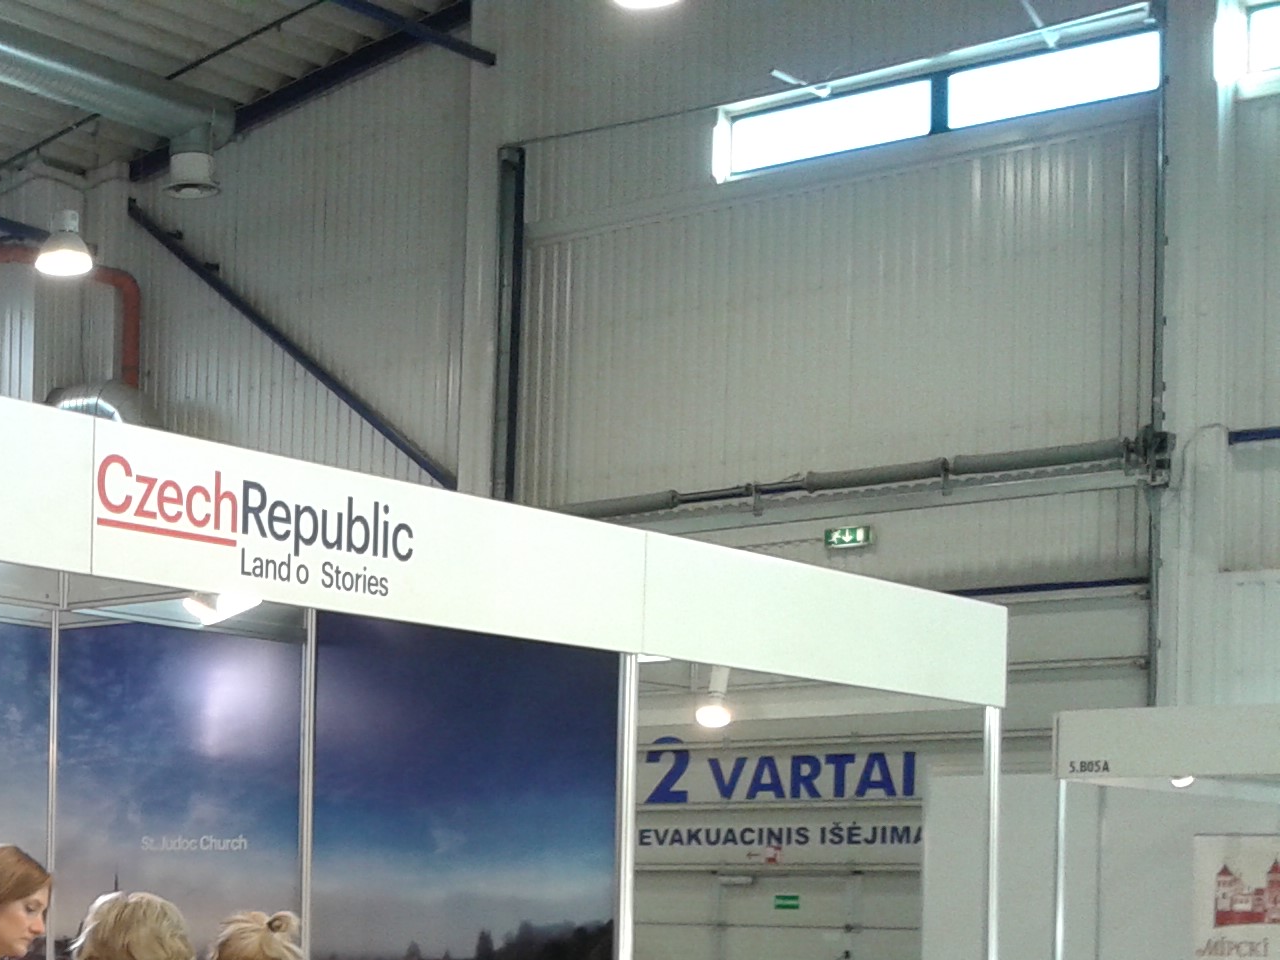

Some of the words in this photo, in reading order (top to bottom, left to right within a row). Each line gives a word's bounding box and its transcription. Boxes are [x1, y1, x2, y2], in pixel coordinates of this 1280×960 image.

[240, 547, 291, 582] Land
[321, 561, 389, 596] Stories
[645, 736, 690, 804] 2
[707, 751, 917, 801] VARTAI
[200, 834, 248, 851] Church
[638, 827, 810, 847] EVAKUACINIS
